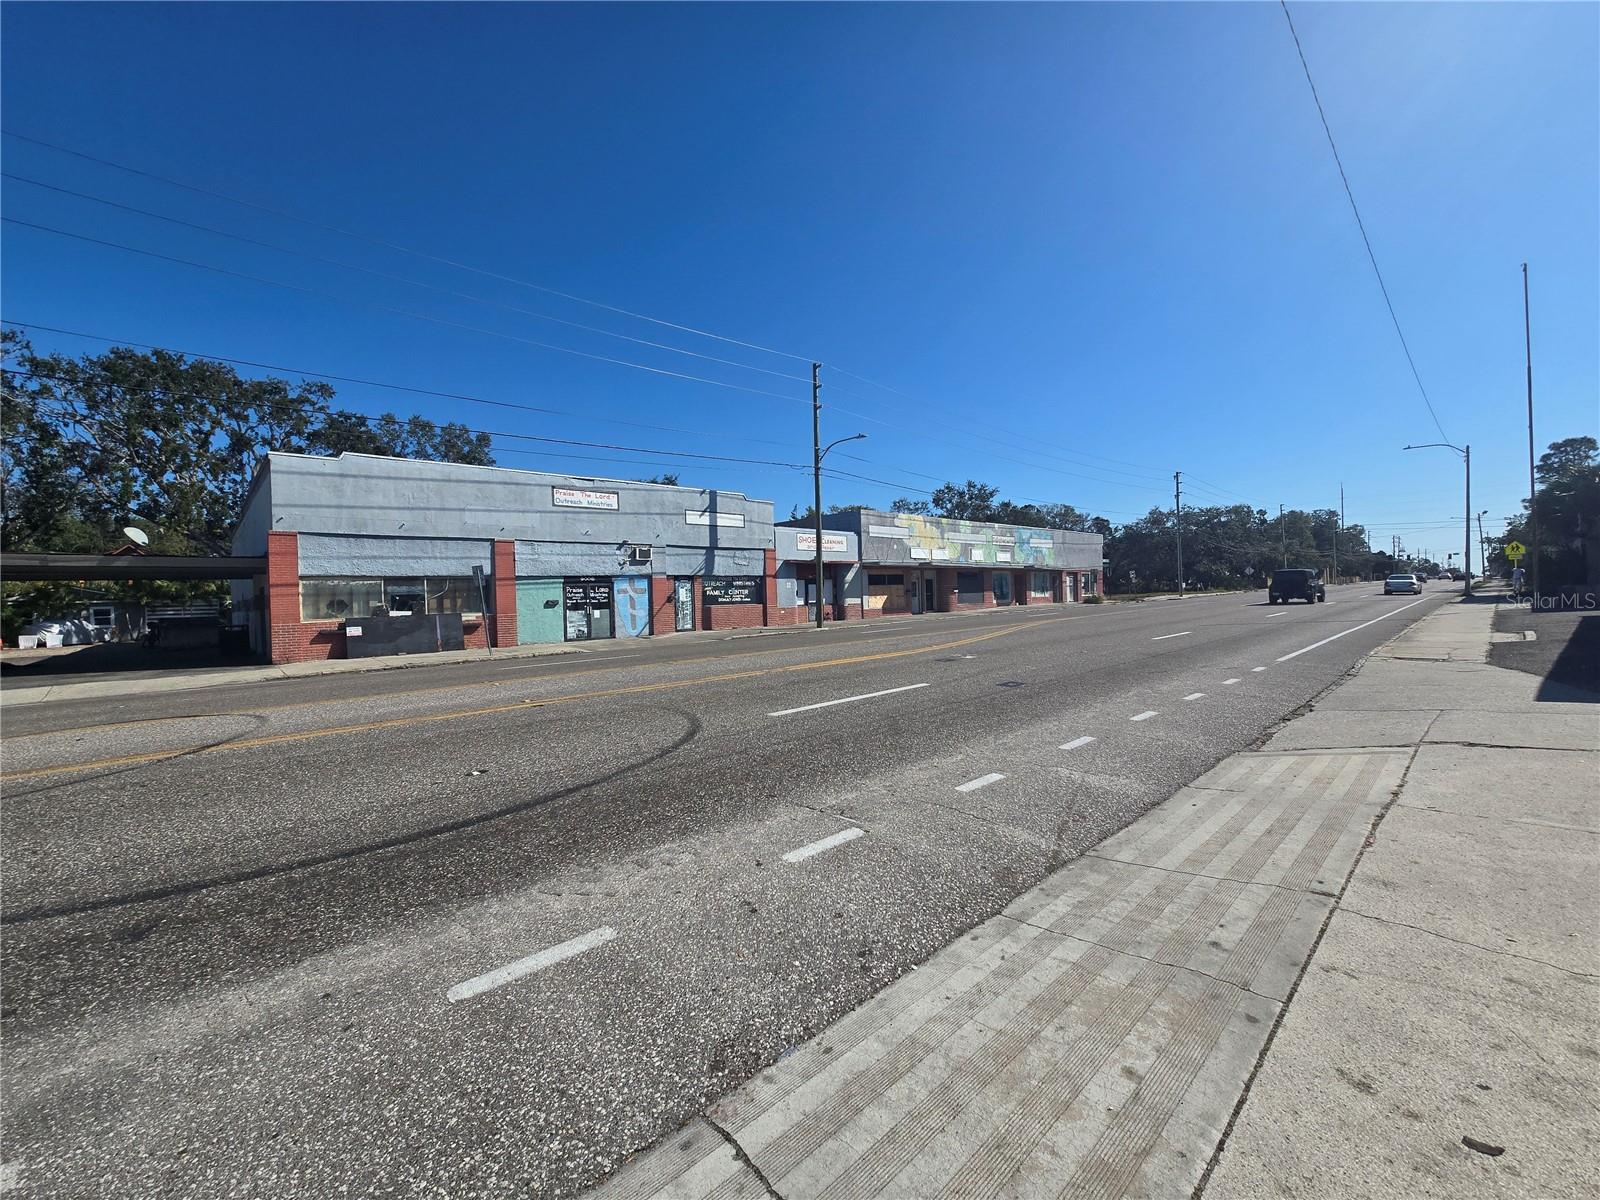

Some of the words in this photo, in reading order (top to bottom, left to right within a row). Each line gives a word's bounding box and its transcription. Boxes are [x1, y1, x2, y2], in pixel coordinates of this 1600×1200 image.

[555, 489, 575, 497] Praise
[556, 497, 583, 505] Outreach
[587, 499, 613, 508] Ministries
